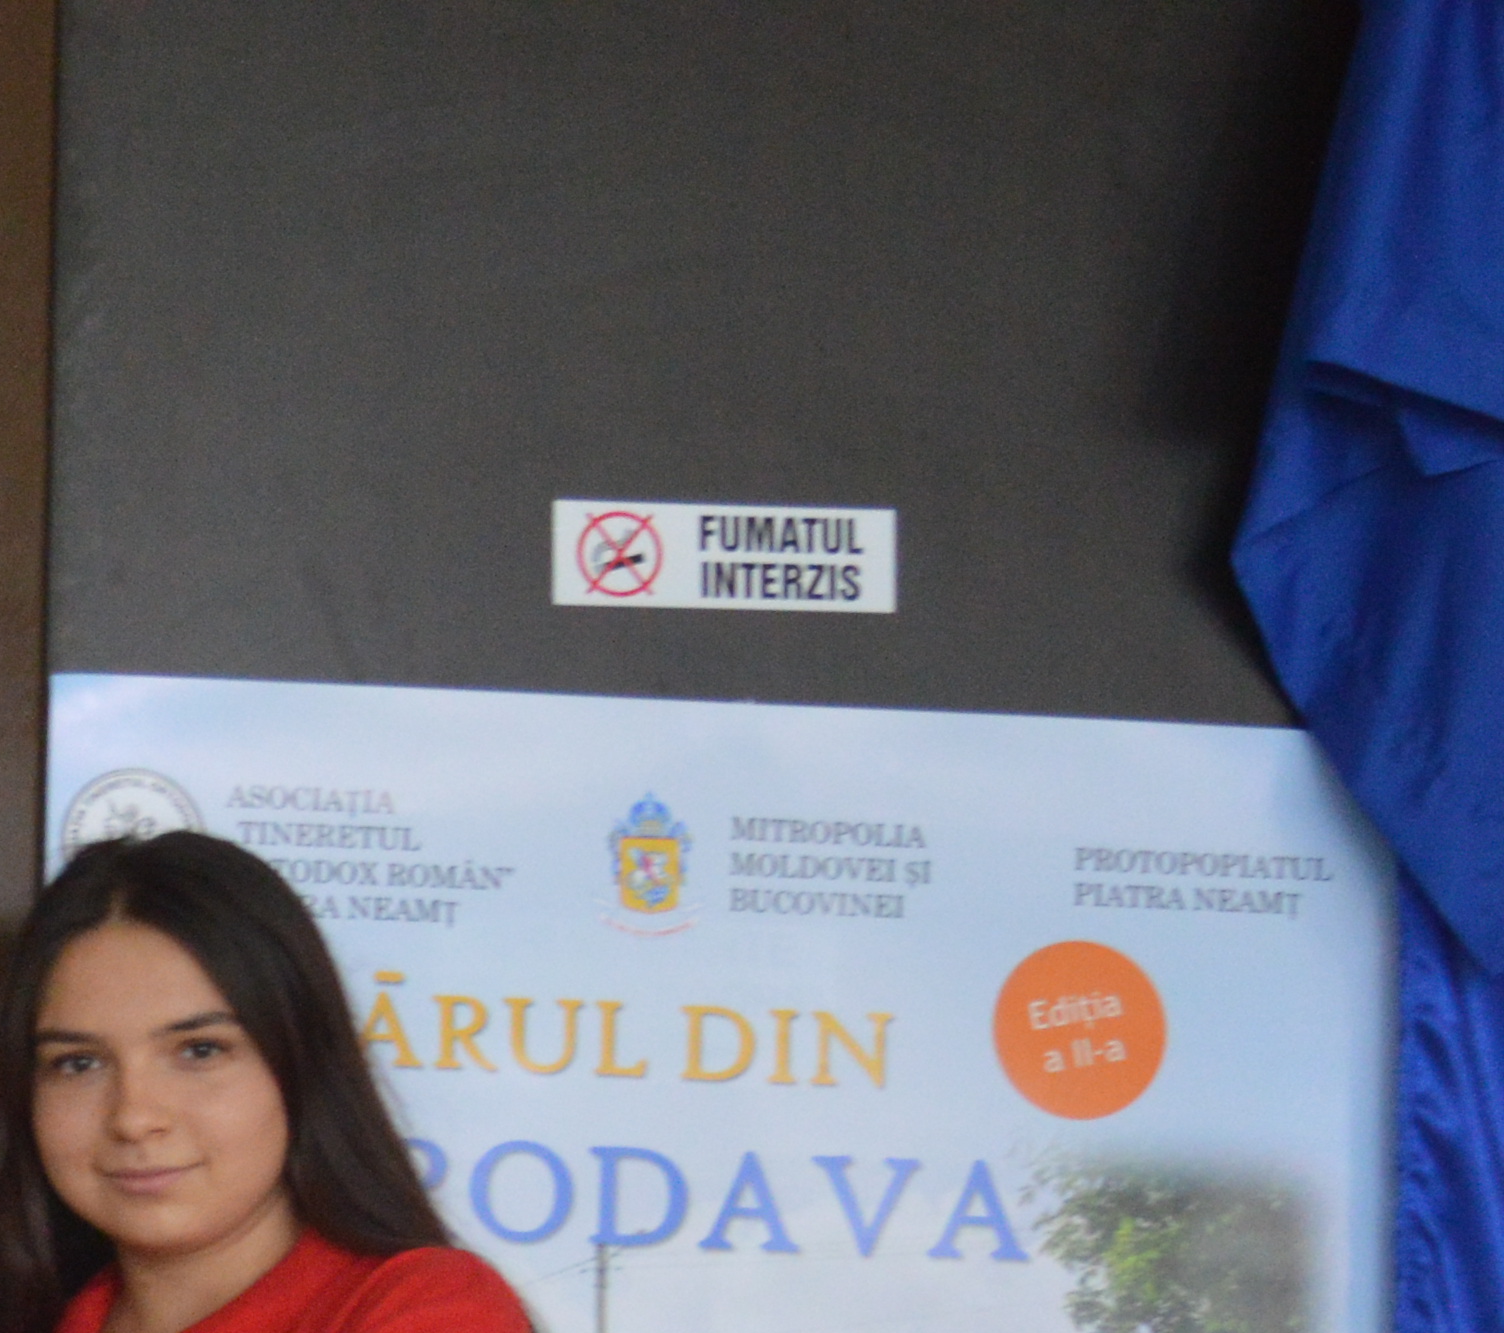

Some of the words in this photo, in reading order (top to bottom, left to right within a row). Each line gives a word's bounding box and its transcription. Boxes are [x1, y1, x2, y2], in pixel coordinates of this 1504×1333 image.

[696, 513, 865, 559] FUMATUL
[698, 559, 863, 603] INTERZIS
[730, 815, 927, 849] MITROPOLIA
[270, 858, 382, 889] TODOX
[729, 852, 897, 884] MOLDOVEI
[1073, 846, 1335, 883] PROTOPOPIATUL
[728, 887, 906, 919] BUCOVINEI
[1073, 881, 1186, 912] PIATRA
[680, 1003, 896, 1089] DIN
[1043, 1047, 1067, 1074] a
[405, 1136, 1031, 1265] ODAVA
